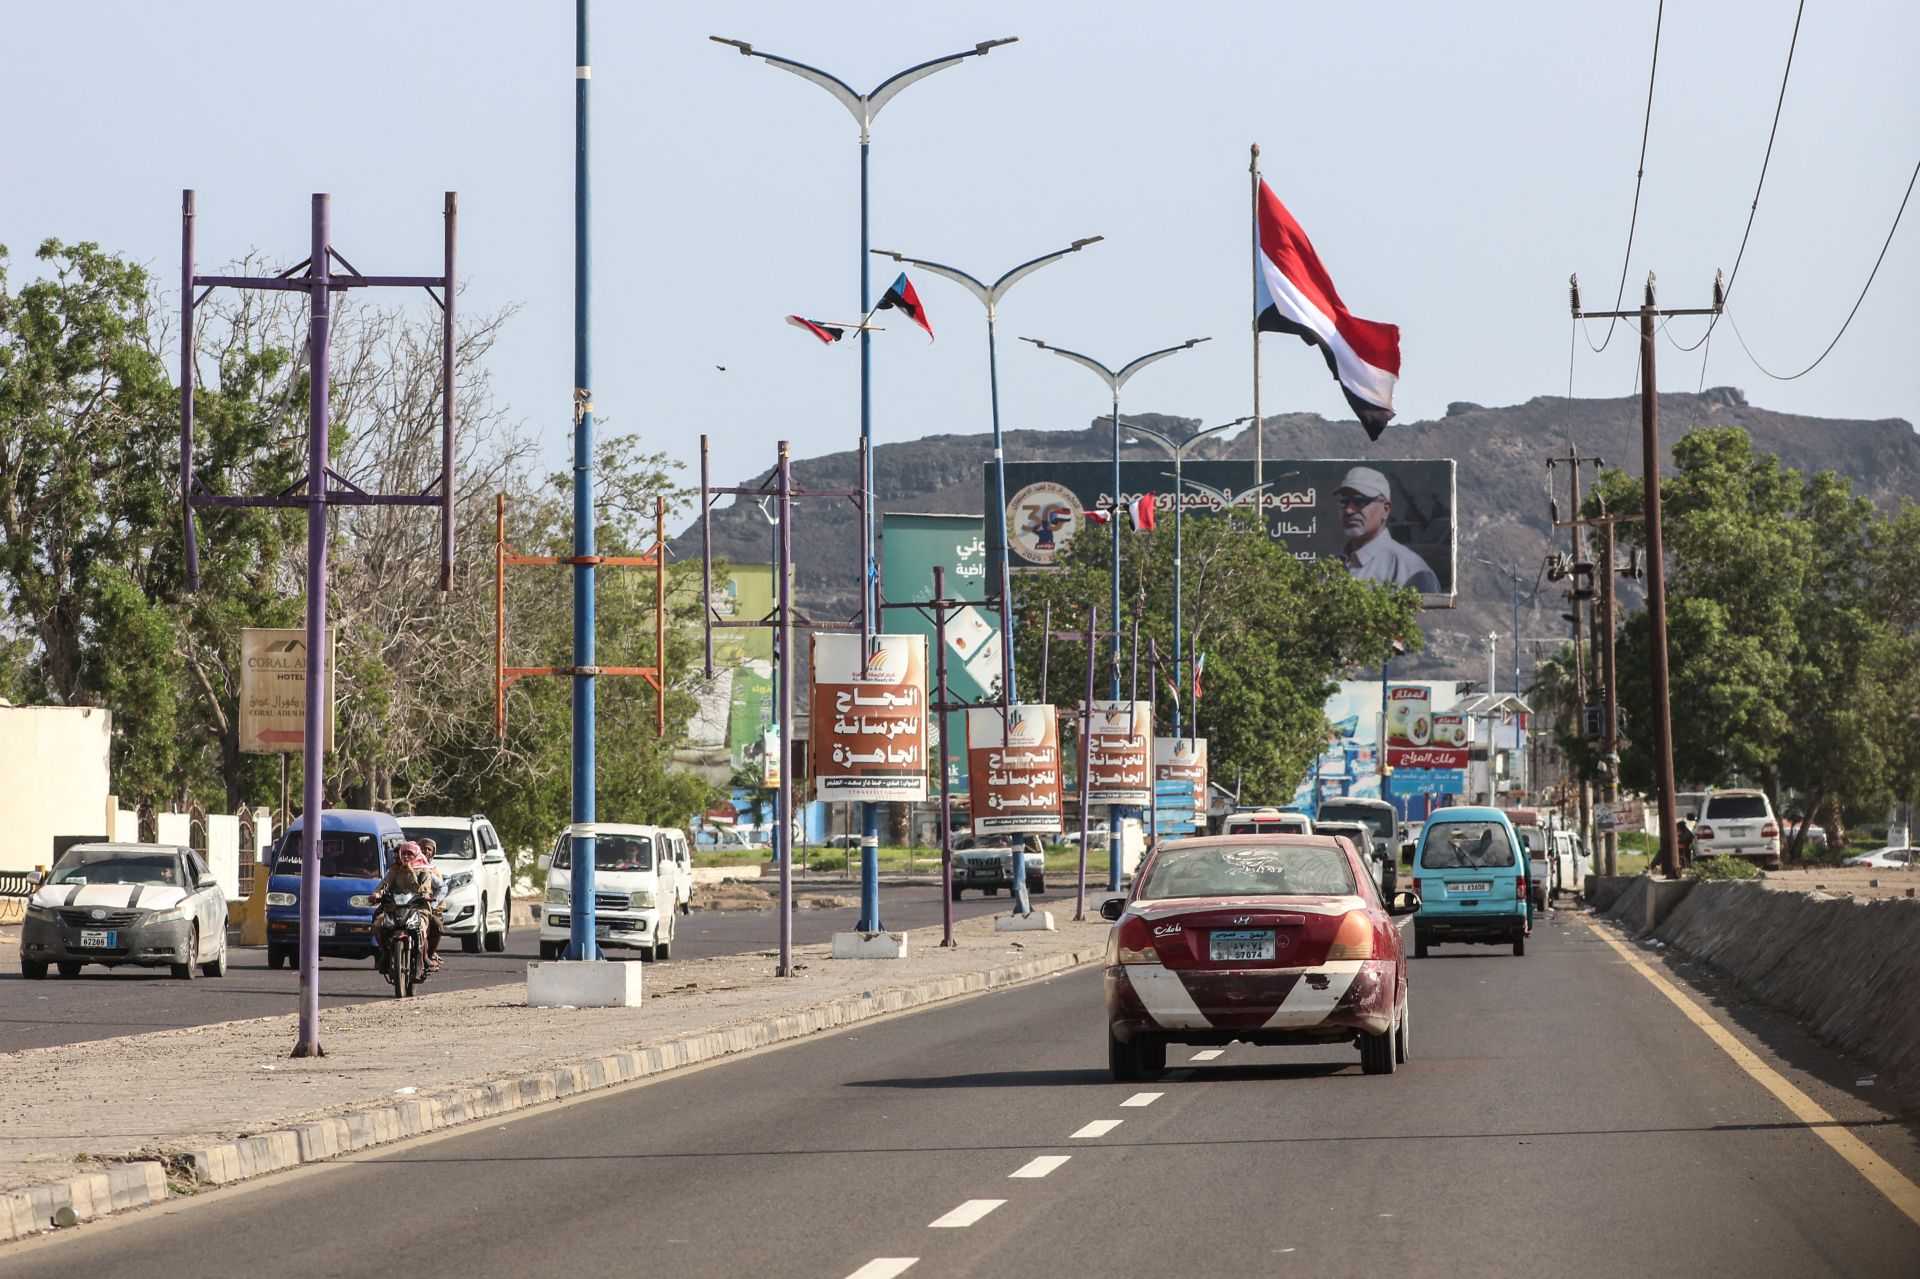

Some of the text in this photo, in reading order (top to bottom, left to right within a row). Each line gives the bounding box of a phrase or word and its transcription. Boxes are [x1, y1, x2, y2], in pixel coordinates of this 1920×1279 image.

[1280, 488, 1317, 512] نحو
[1271, 517, 1317, 537] أبطال
[248, 657, 291, 669] CORAL
[836, 687, 918, 713] النجاح
[249, 709, 274, 717] CORAL
[833, 714, 919, 740] للخرسانة
[1090, 735, 1144, 752] النجاح
[832, 743, 918, 769] الجاهزة
[989, 748, 1055, 769] النجاح
[1089, 753, 1144, 768] للخرسانة
[1400, 751, 1457, 766] ملك المزاج
[988, 769, 1056, 788] للخرسانة
[1088, 771, 1144, 786] الجاهزة
[988, 791, 1057, 811] الجاهزة
[83, 938, 105, 946] 67208
[1250, 931, 1268, 939] اليمن
[1235, 951, 1263, 959] 57074
